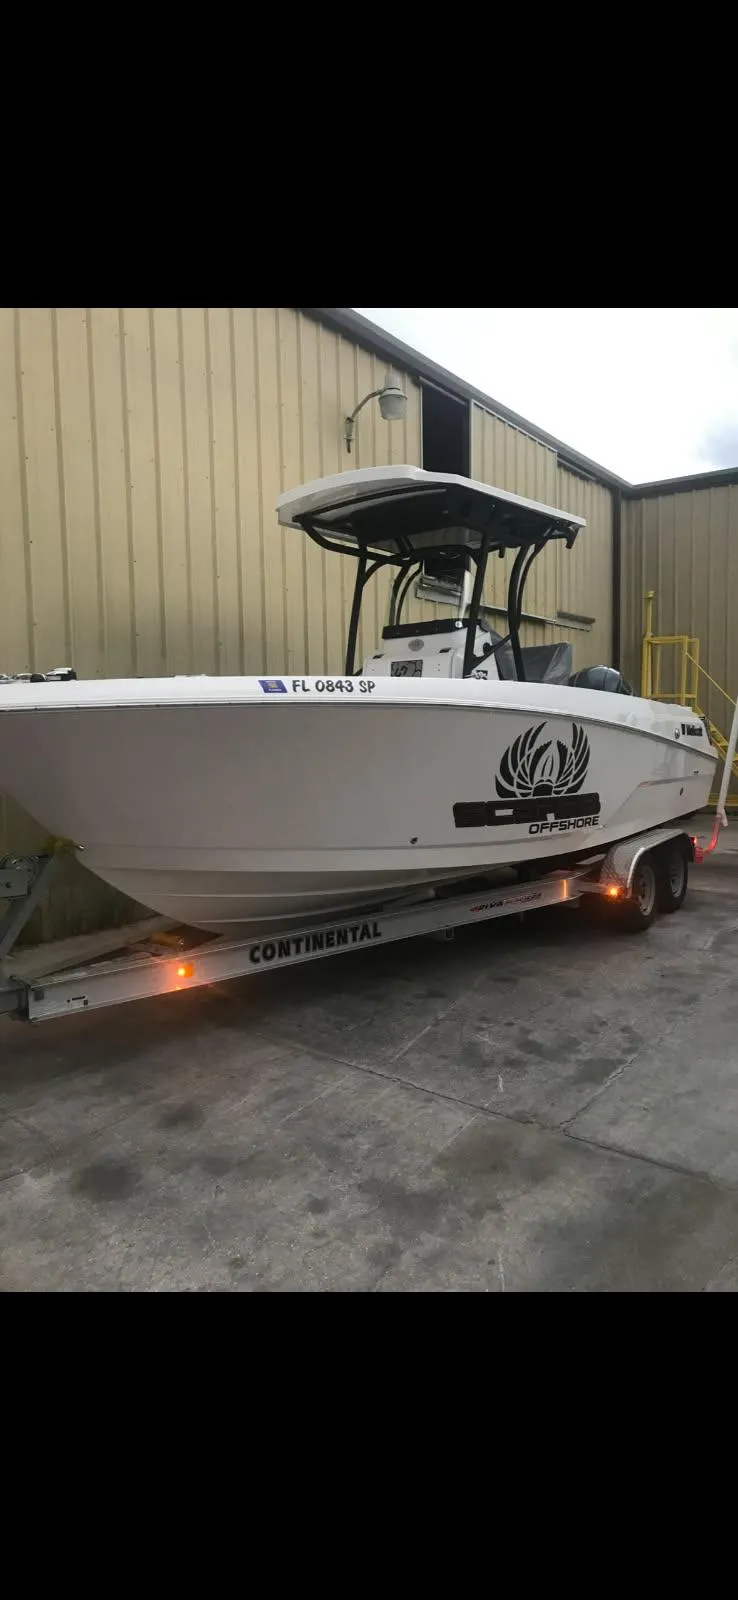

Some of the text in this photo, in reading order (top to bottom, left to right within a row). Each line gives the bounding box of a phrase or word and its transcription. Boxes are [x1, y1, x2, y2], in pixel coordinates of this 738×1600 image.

[292, 679, 376, 693] FL 0843 SP
[528, 815, 600, 835] OFFSHORE
[249, 921, 382, 964] CONTINENTAL
